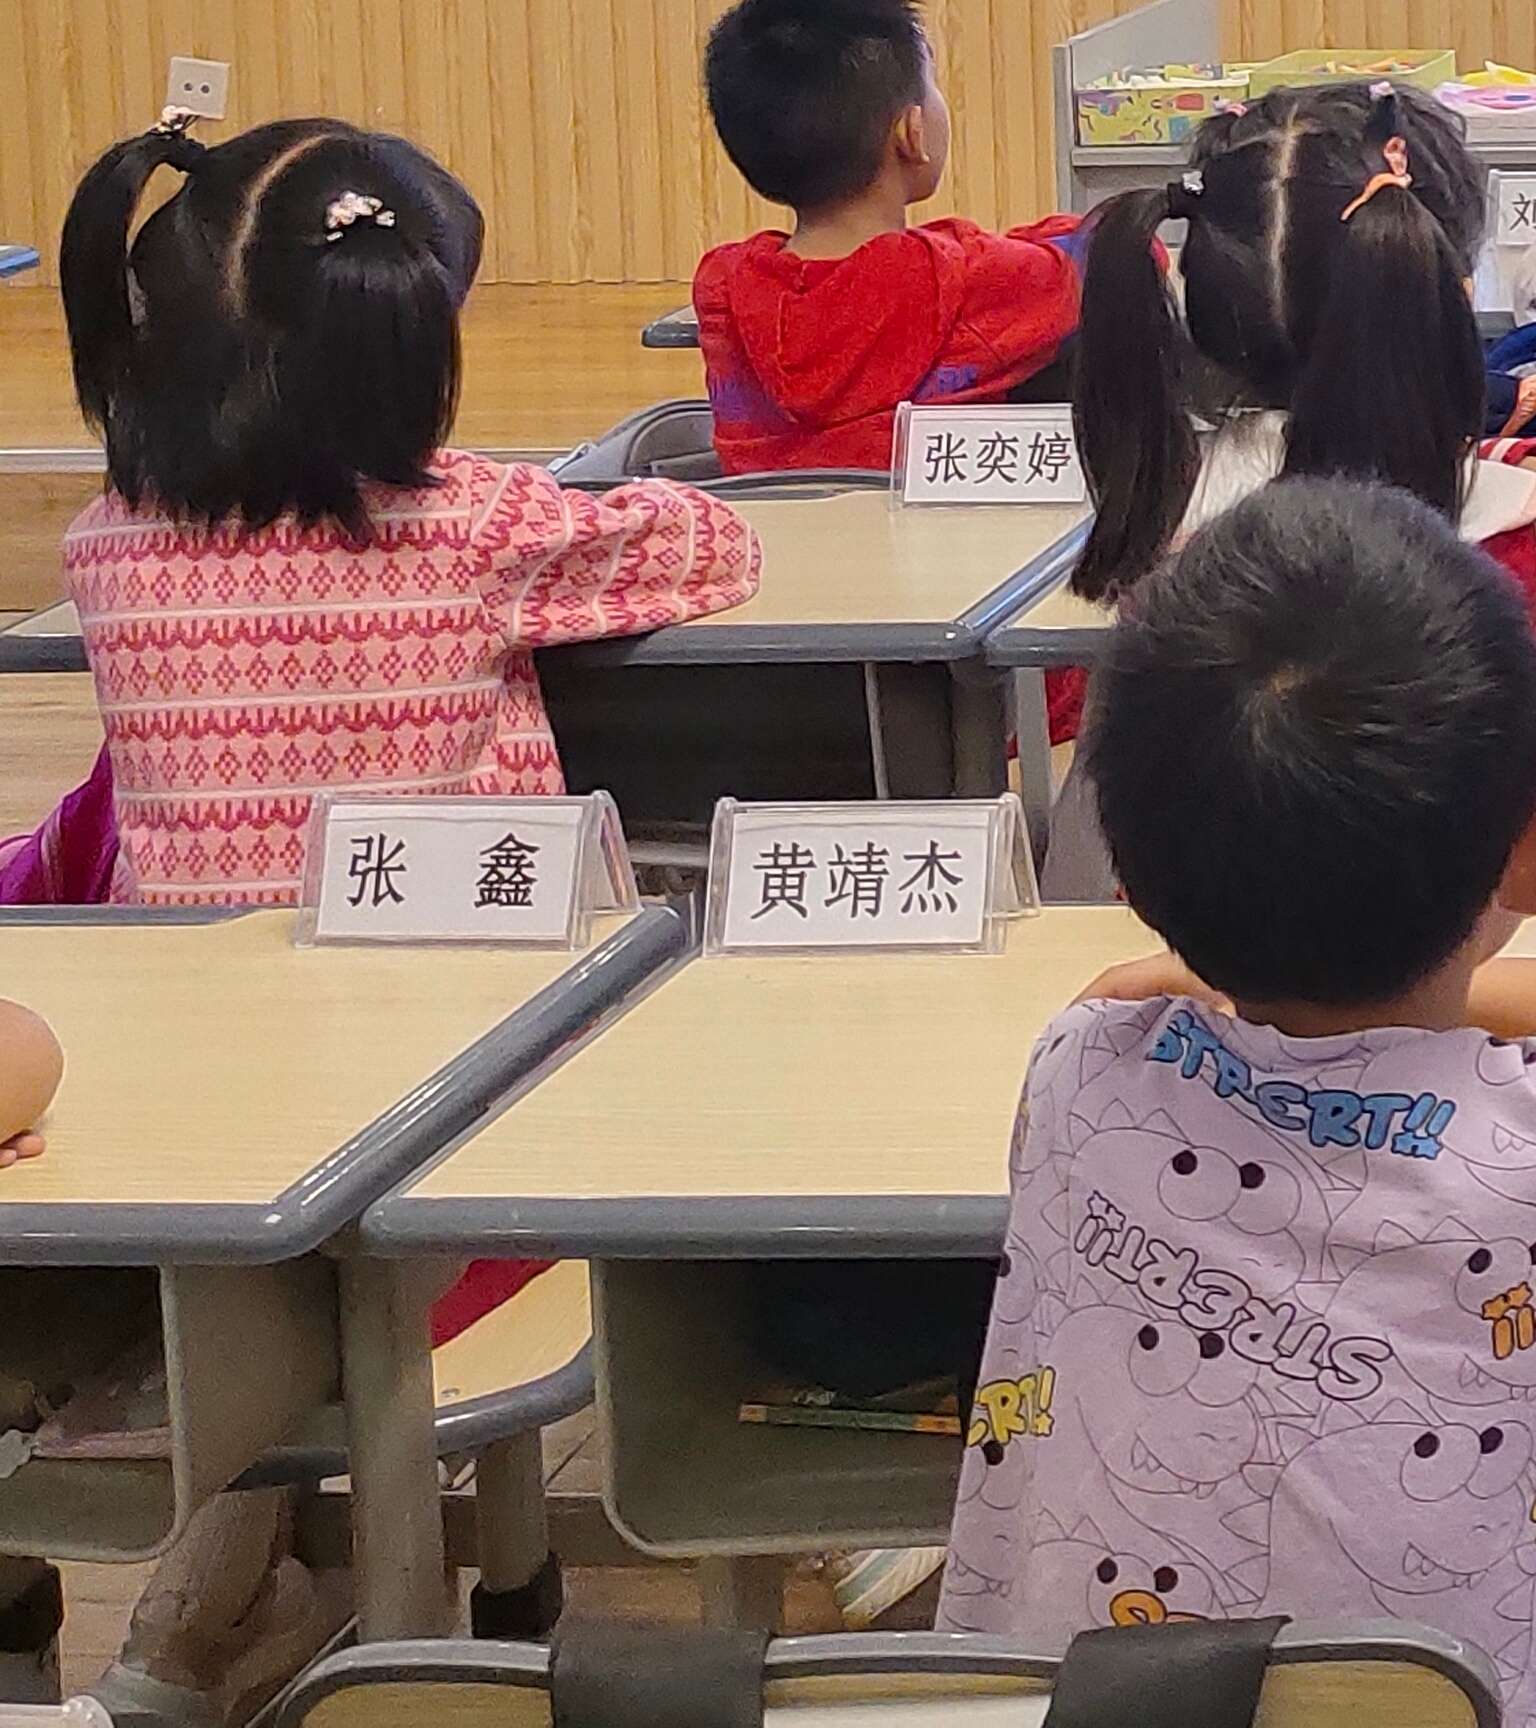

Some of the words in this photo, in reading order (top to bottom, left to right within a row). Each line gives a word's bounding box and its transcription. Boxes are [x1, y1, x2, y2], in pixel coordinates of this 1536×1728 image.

[924, 431, 1073, 485] 张奕婷
[750, 838, 964, 921] 黄靖杰
